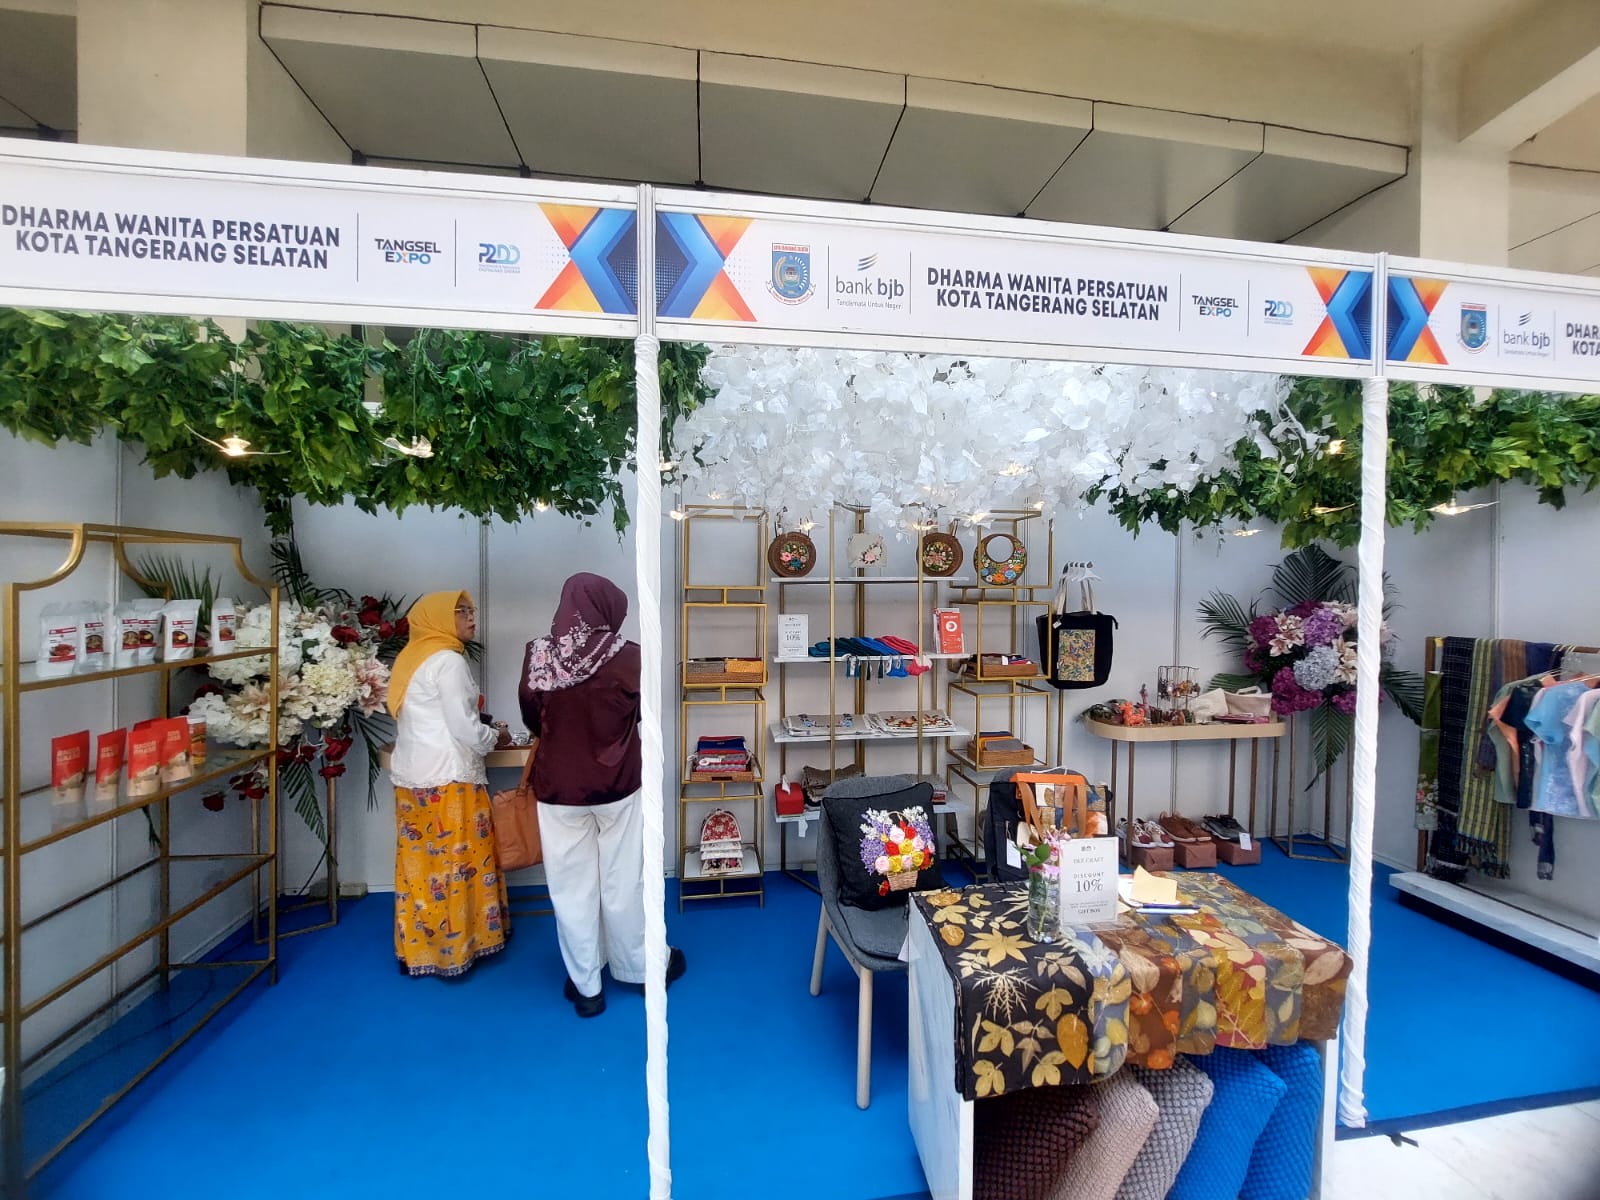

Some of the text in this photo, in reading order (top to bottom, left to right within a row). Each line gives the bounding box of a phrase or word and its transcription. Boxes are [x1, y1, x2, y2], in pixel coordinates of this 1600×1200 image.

[1, 204, 340, 248] DHARMA WANITA PERSATUAN
[16, 229, 328, 270] KOTA TANGERANG SELATAN
[374, 238, 441, 254] TANGSEL
[385, 251, 431, 265] EXPO
[836, 275, 905, 300] bank bjb
[927, 267, 1168, 303] DHARMA WANITA PERSATUAN
[936, 288, 1160, 321] KOTA TANGERANG SELATAN
[1191, 295, 1239, 308] TANGSEL
[1199, 306, 1232, 318] EXPO
[1503, 328, 1551, 350] bank bjb
[1566, 322, 1600, 340] DHAR
[1073, 871, 1105, 880] DISCOUNT
[1076, 879, 1104, 893] 10%
